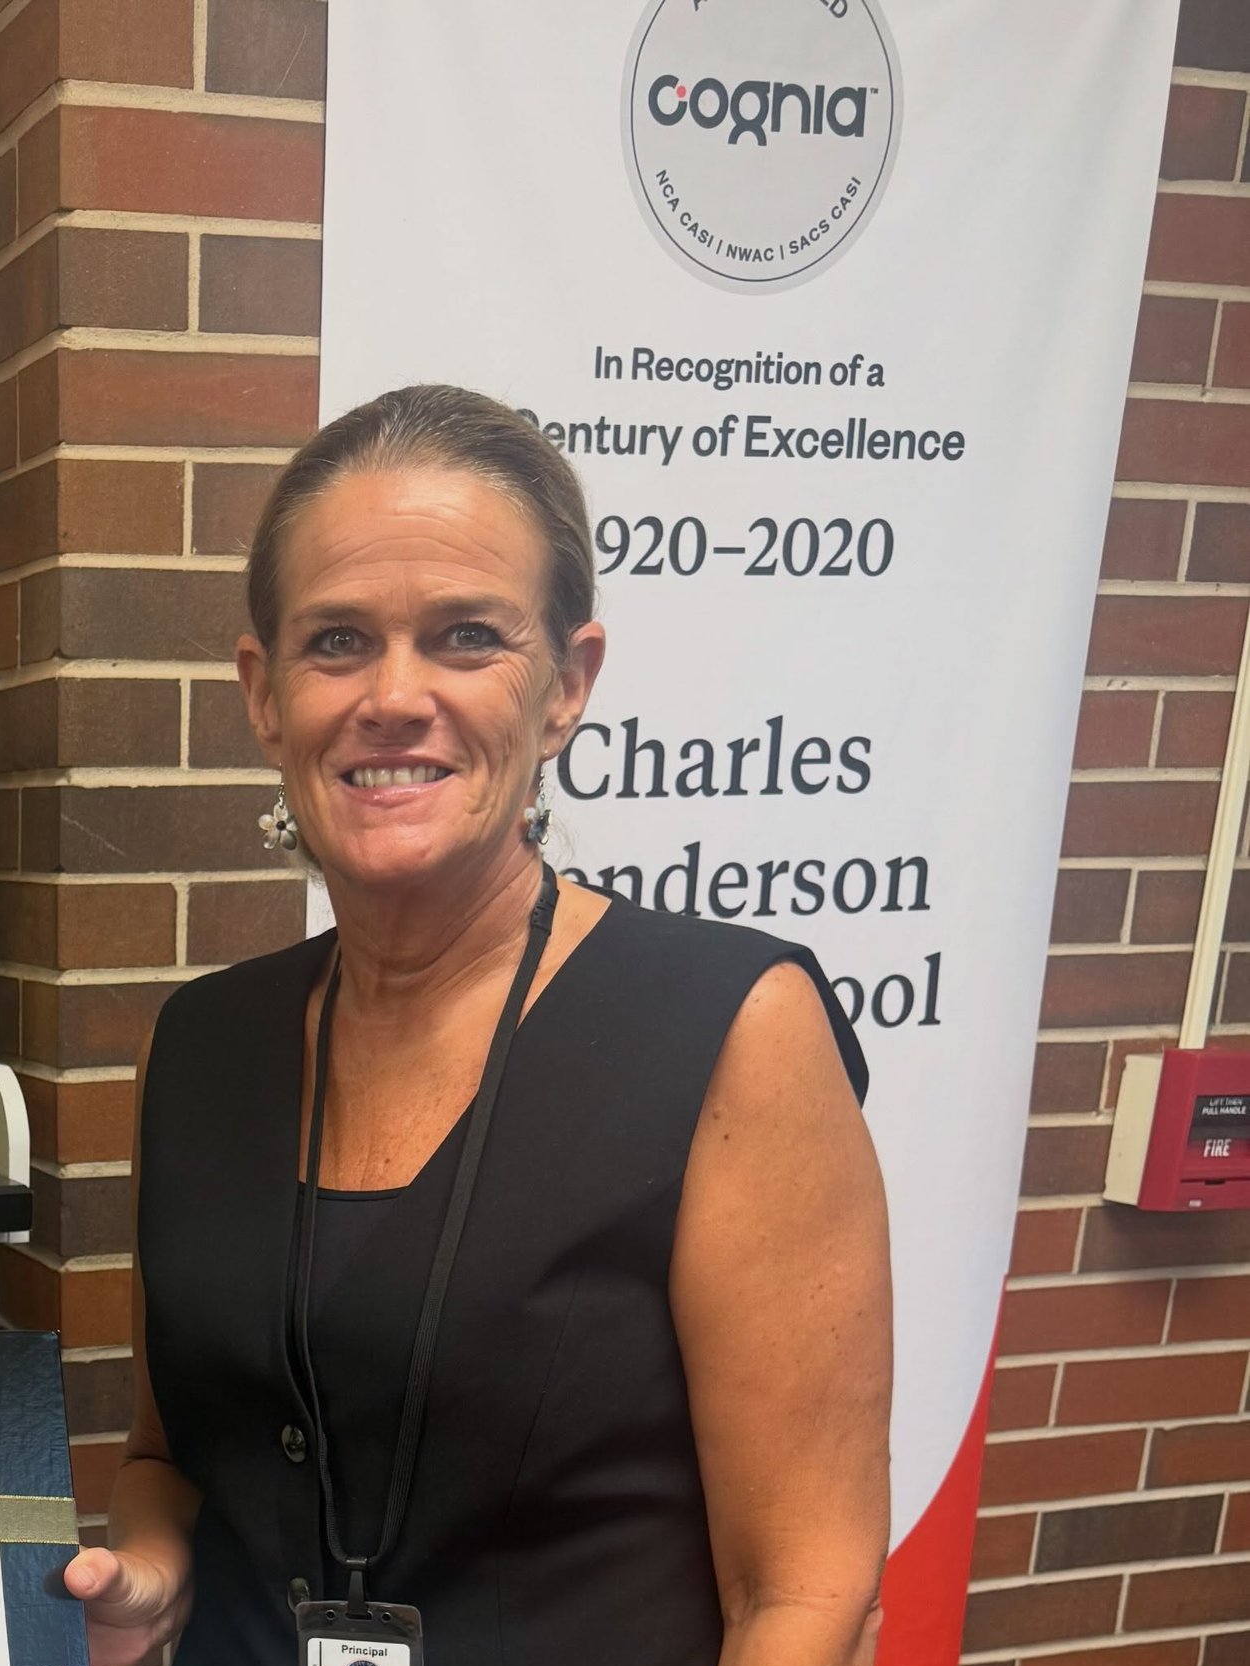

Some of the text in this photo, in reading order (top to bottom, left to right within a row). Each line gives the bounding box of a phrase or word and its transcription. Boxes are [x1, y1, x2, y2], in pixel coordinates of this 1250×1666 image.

[648, 74, 867, 147] cognia
[656, 169, 680, 212] NCA
[679, 212, 714, 248] CASI
[726, 243, 775, 263] NWAC
[789, 219, 830, 254] SACS
[831, 177, 861, 220] CASI
[594, 346, 886, 391] In Recognition of a
[692, 415, 740, 457] of
[744, 415, 966, 462] Excellence
[595, 515, 895, 577] 920–2020
[556, 715, 872, 801] Charles
[1202, 1105, 1247, 1115] PULL HANDLE
[1203, 1139, 1231, 1157] FIRE
[341, 1644, 388, 1657] Principal
